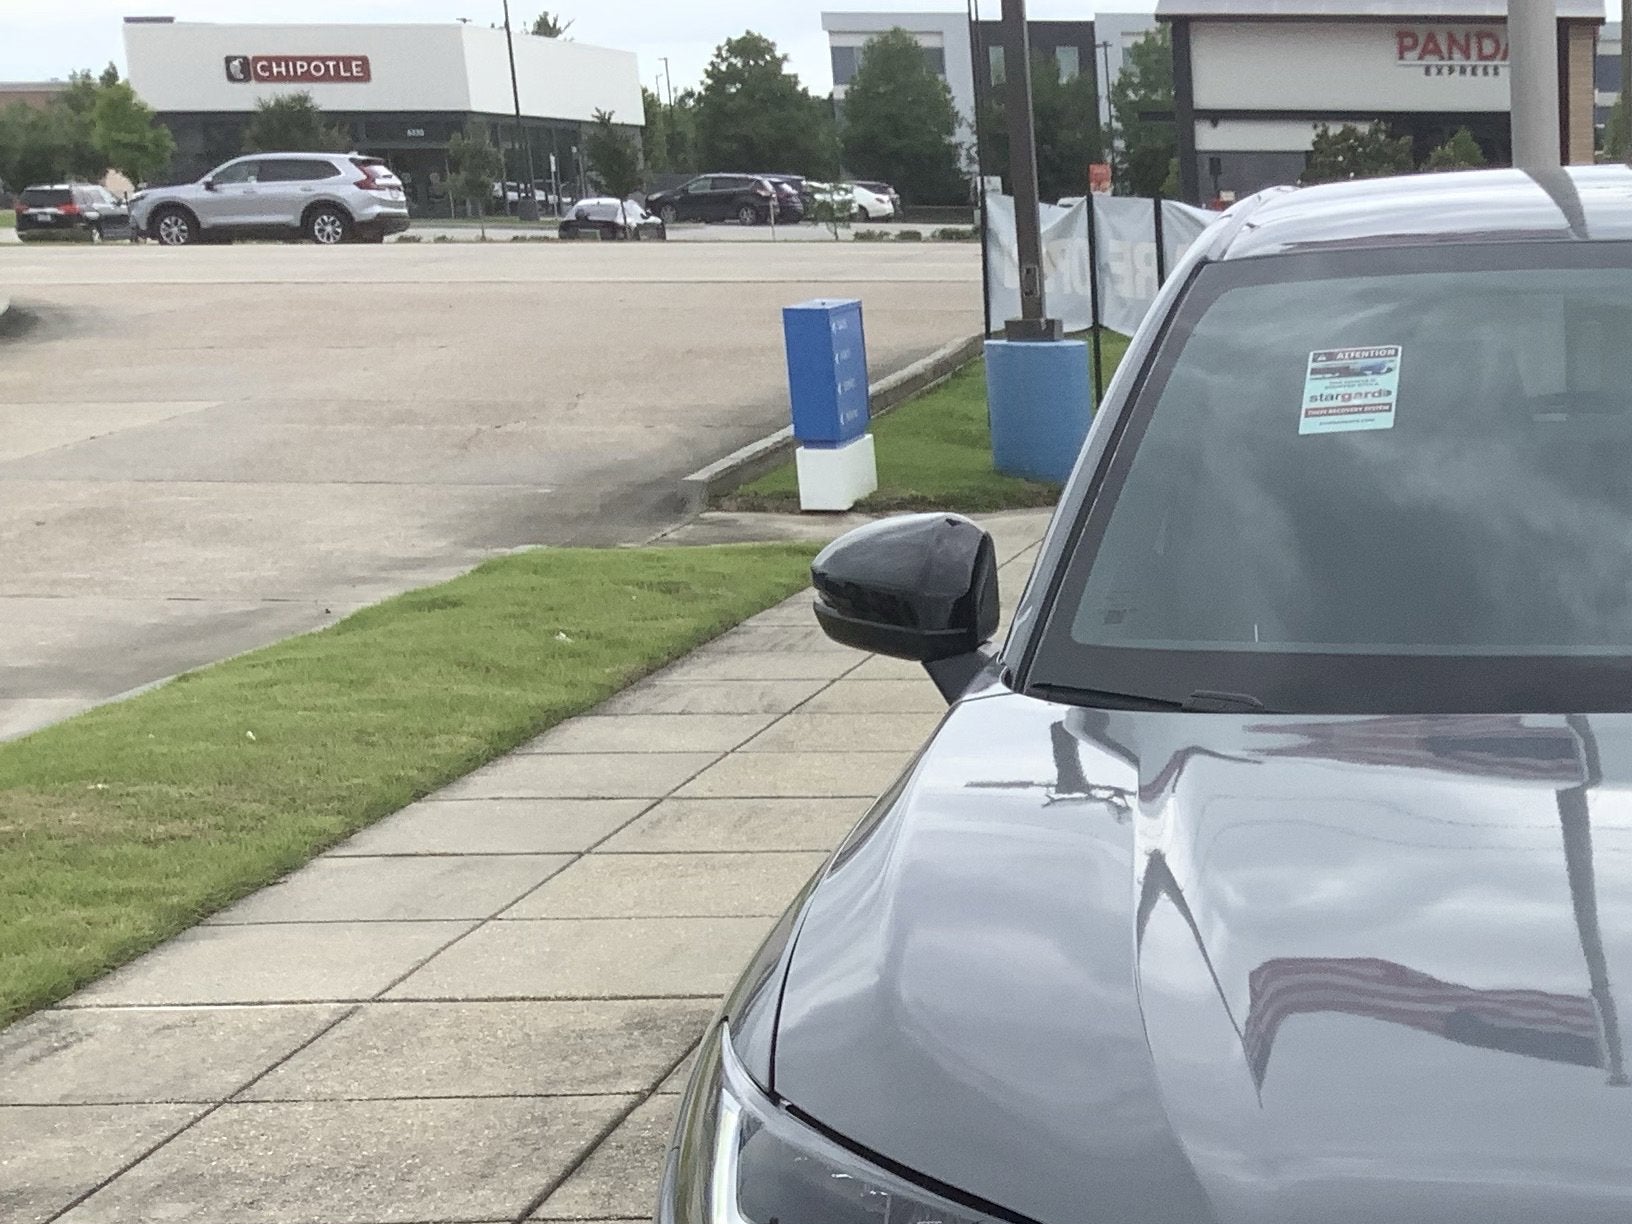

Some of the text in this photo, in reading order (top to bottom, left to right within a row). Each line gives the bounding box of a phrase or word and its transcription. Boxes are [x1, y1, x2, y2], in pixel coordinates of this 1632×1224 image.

[256, 60, 364, 77] CHIPOTLE
[1424, 64, 1500, 76] EXPRESS
[1336, 349, 1395, 360] ATTENTION
